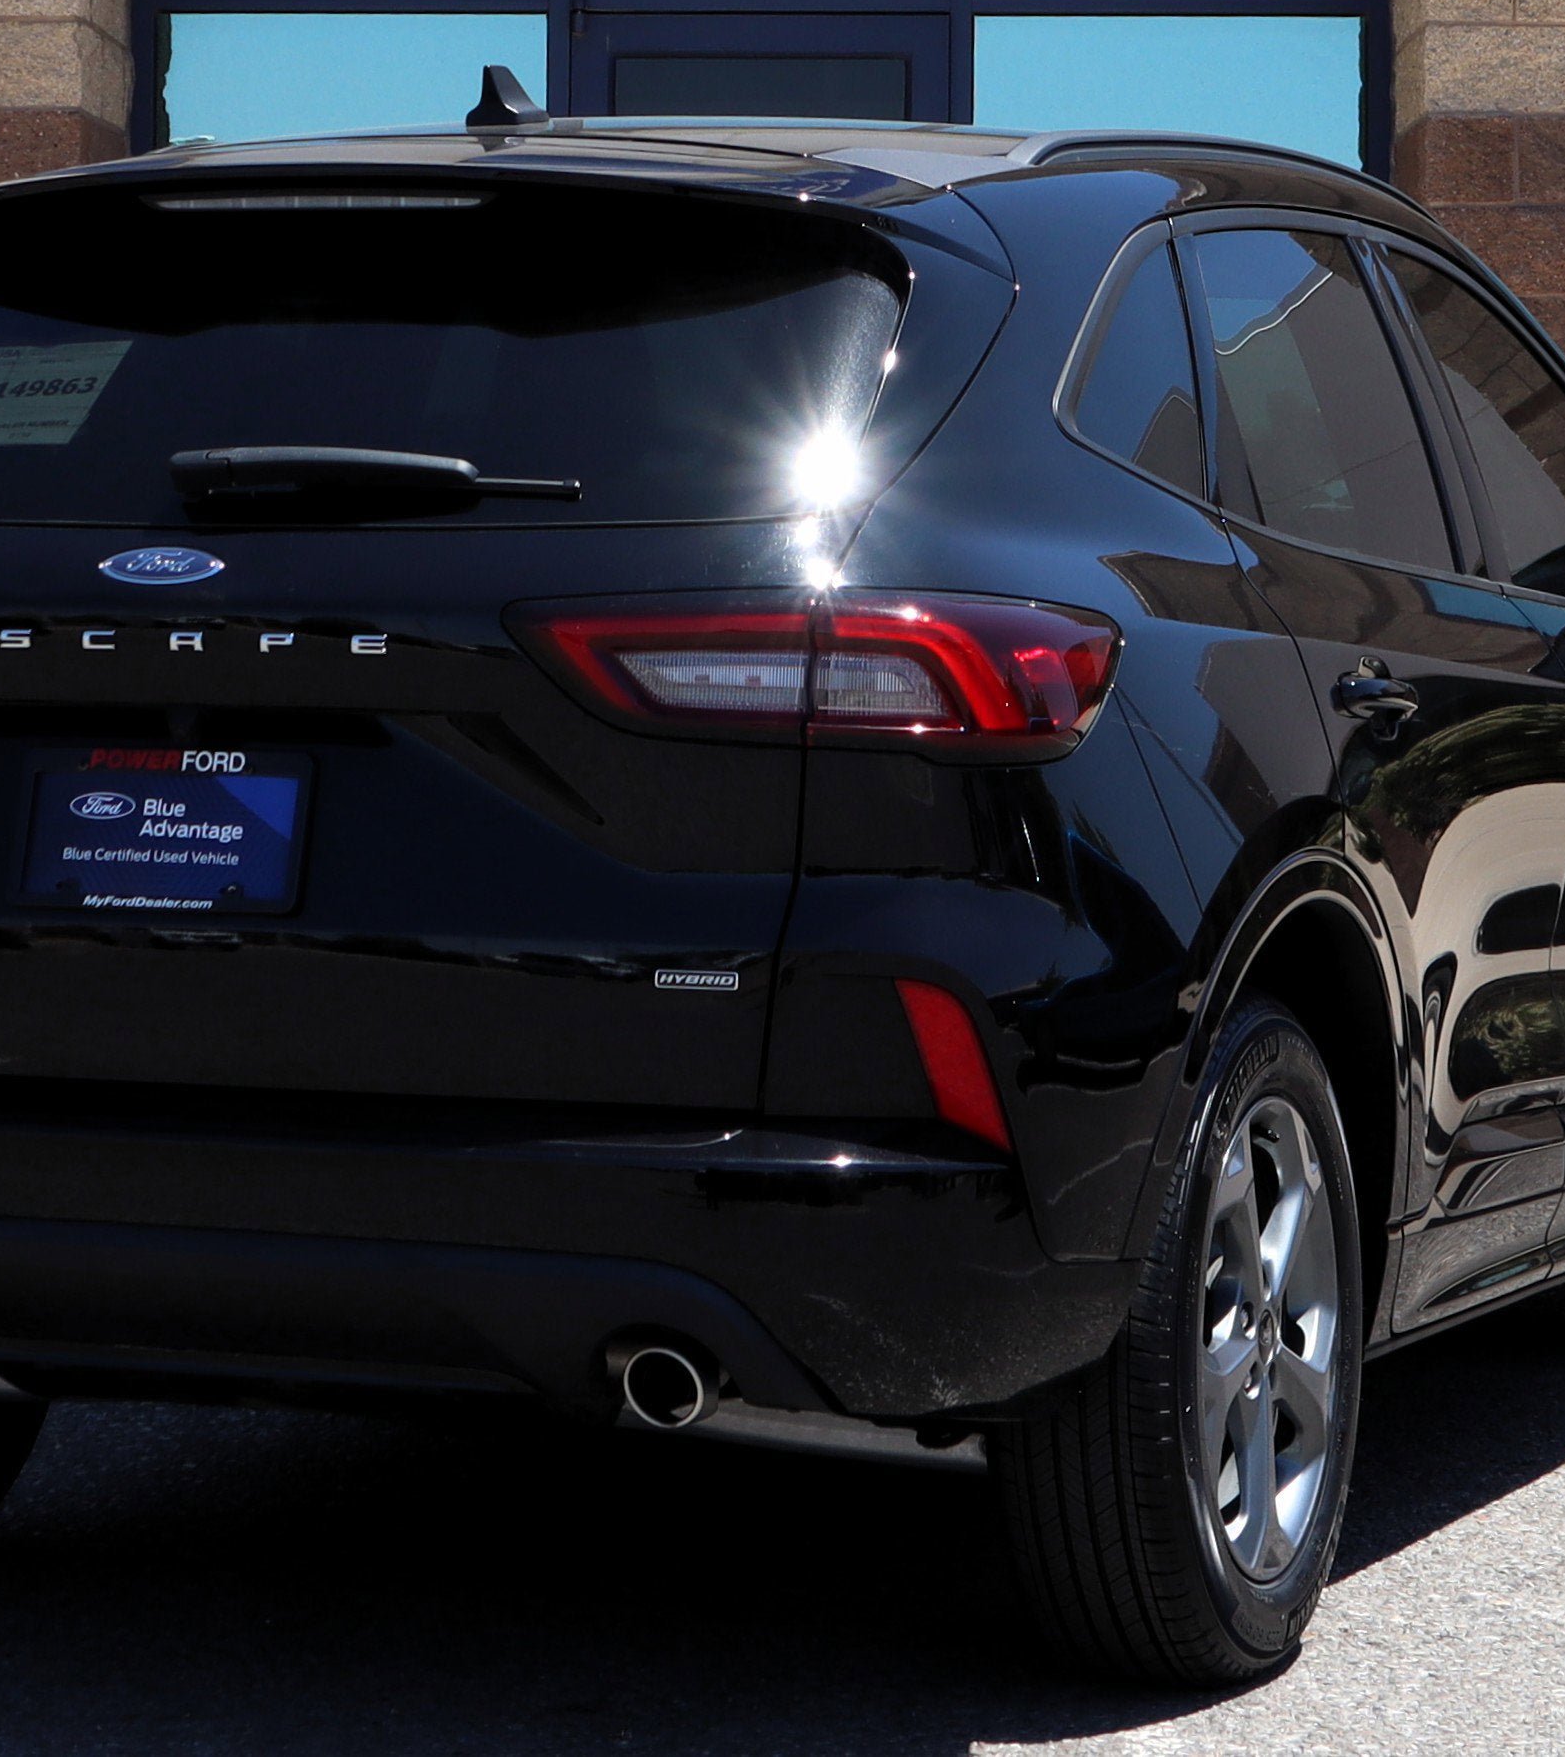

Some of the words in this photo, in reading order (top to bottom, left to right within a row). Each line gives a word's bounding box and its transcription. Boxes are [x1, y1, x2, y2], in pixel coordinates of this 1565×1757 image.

[126, 550, 197, 573] Ford
[80, 795, 124, 817] Ford
[142, 797, 187, 818] Blue
[138, 819, 245, 845] Advantage
[61, 846, 92, 862] Blue
[94, 847, 151, 864] Certified
[153, 848, 189, 865] Used
[191, 850, 241, 867] Vehicle
[82, 893, 214, 912] MyFordDealer.com
[659, 973, 735, 986] HYBRID
